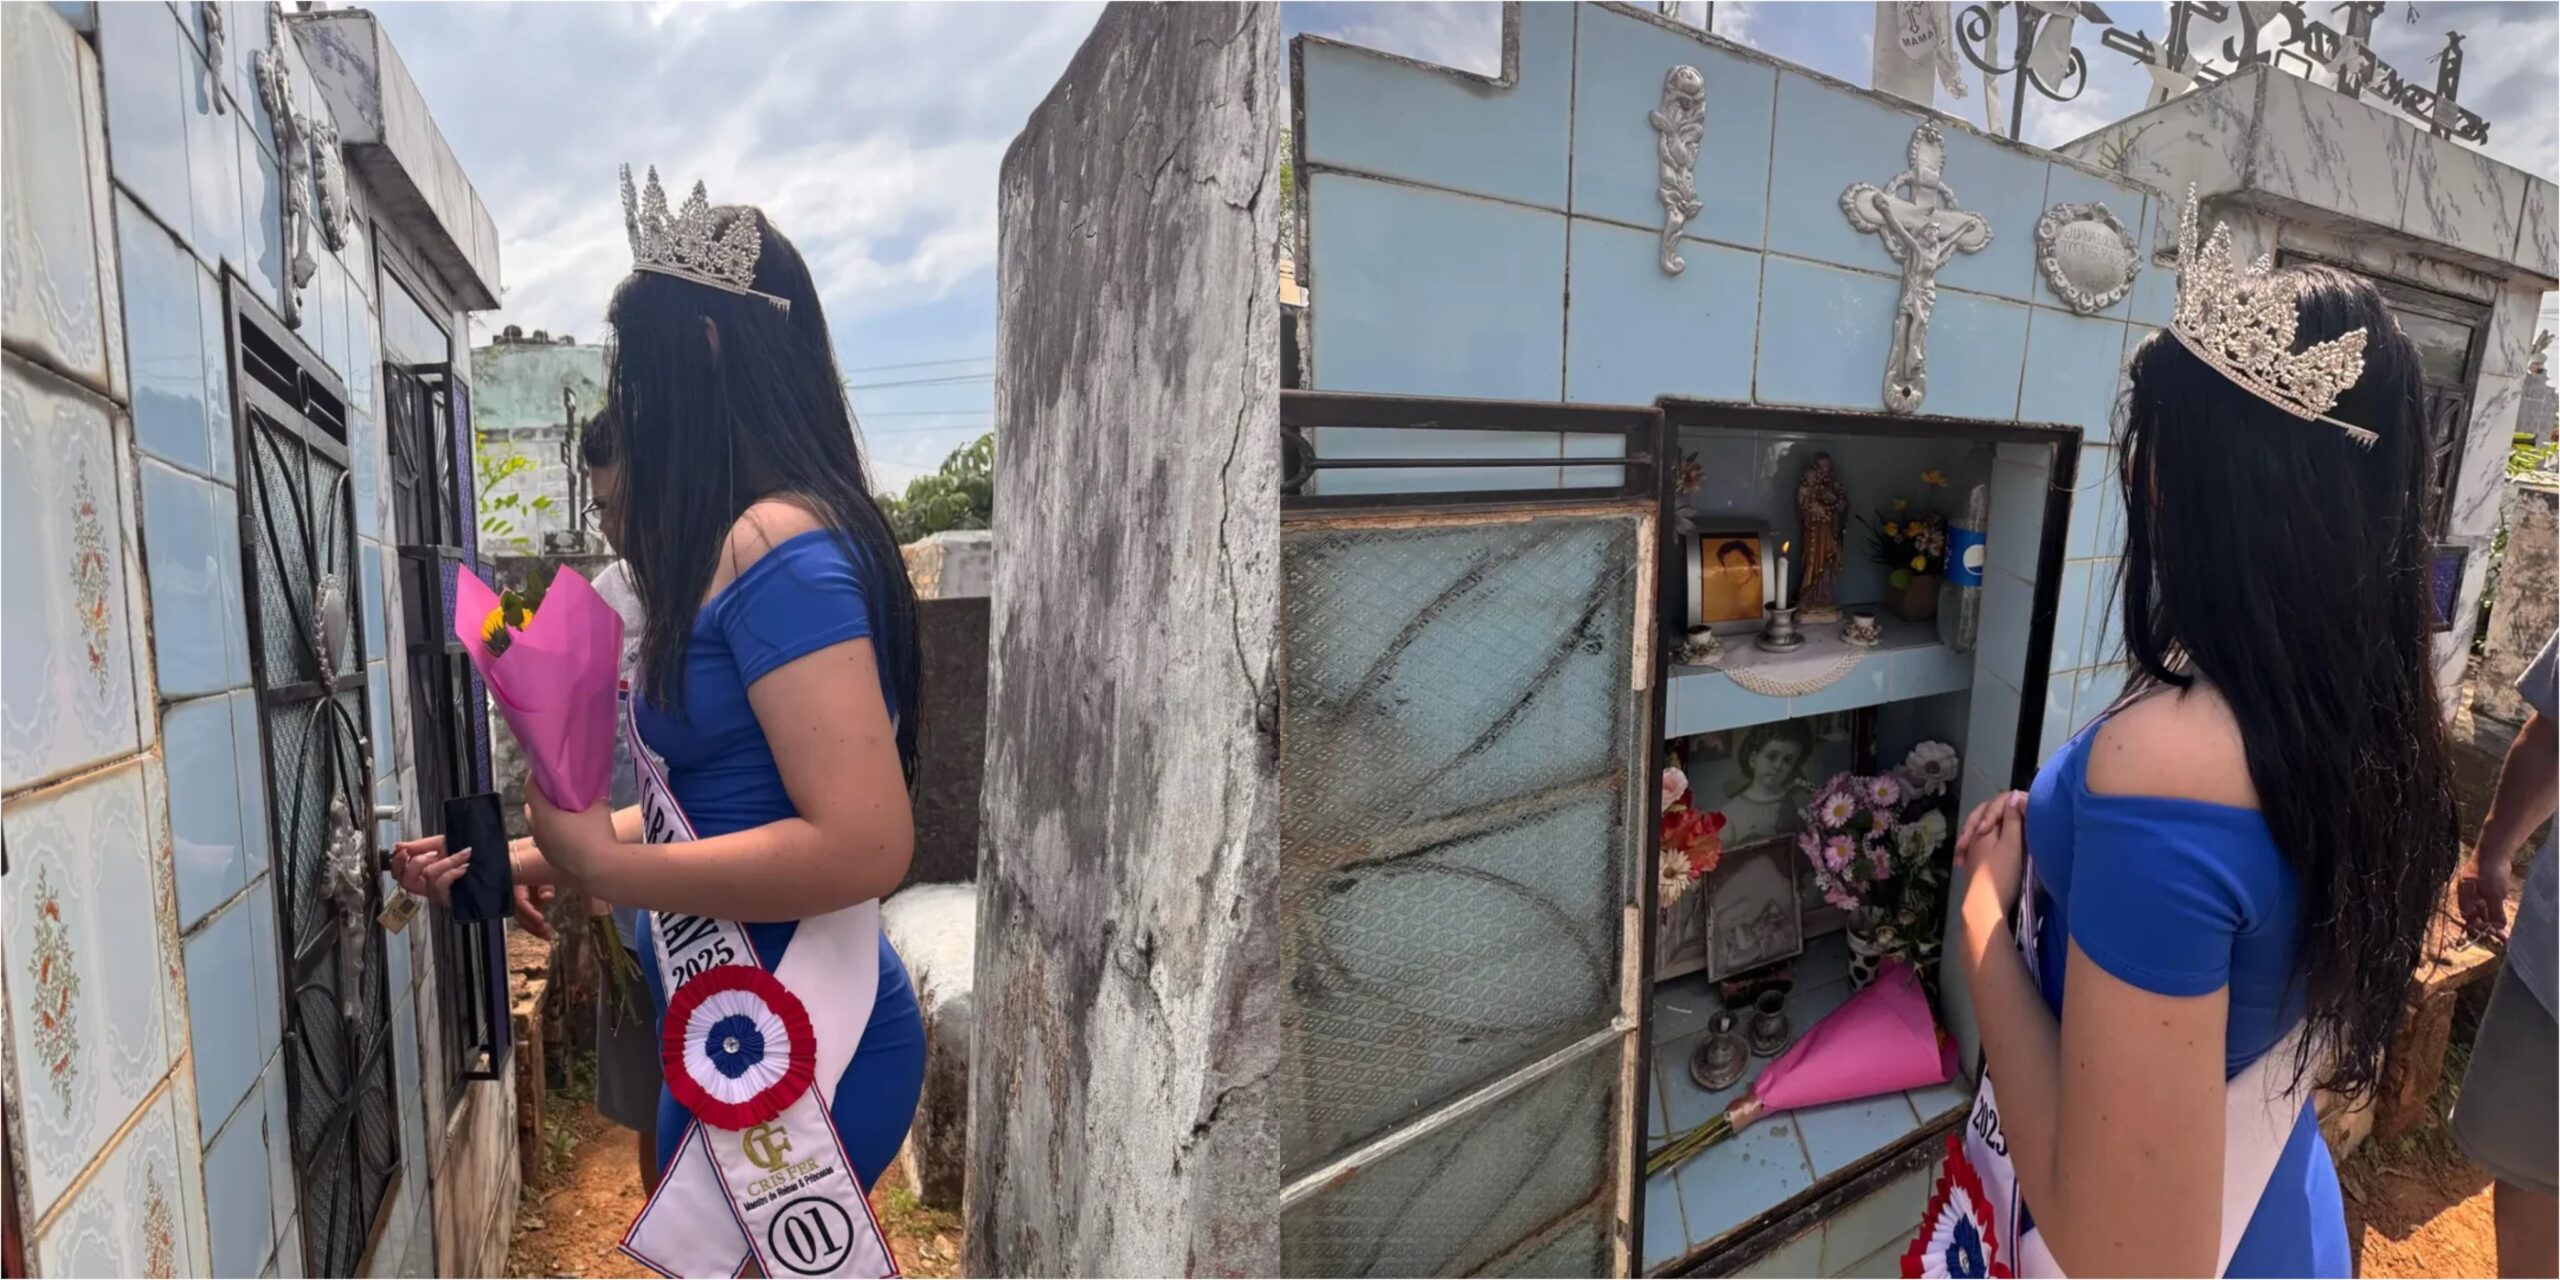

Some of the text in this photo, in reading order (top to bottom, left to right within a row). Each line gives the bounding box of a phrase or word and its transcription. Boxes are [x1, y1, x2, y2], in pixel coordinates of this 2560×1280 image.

[672, 936, 735, 991] 2025
[747, 1156, 818, 1197] CRIS FER
[768, 1192, 778, 1202] de
[776, 1183, 799, 1198] Reinas
[784, 1206, 843, 1265] 01
